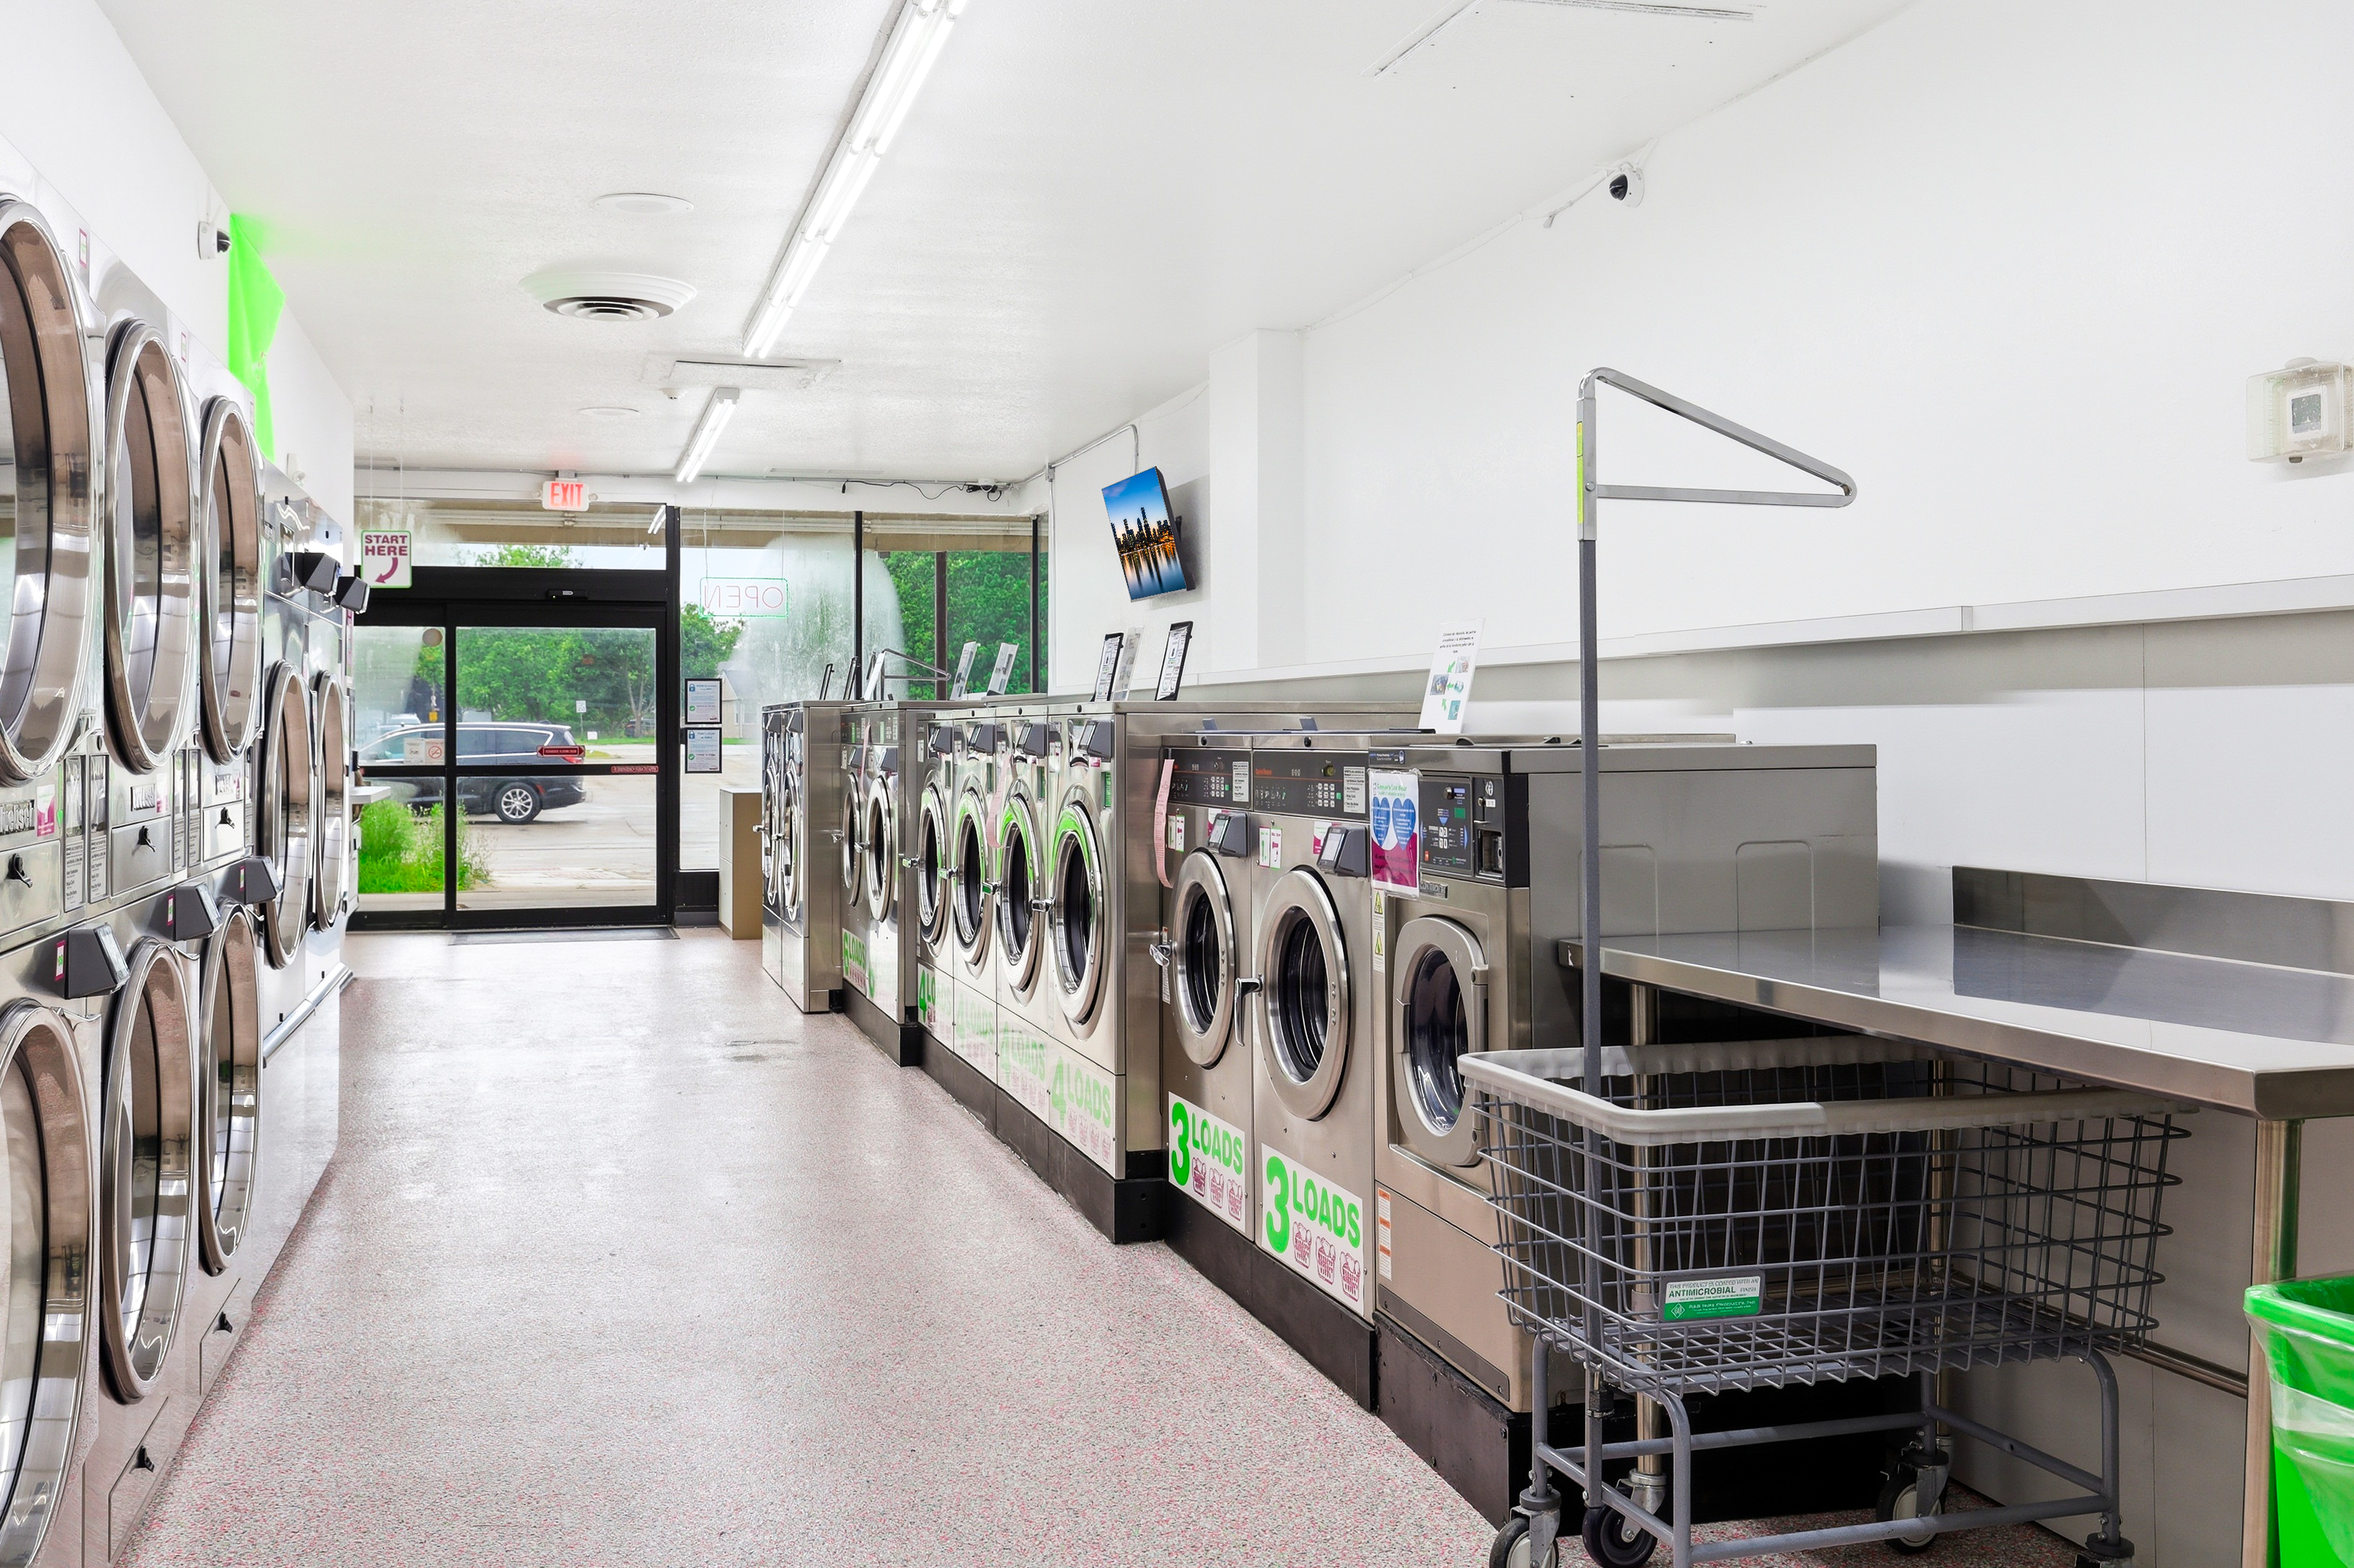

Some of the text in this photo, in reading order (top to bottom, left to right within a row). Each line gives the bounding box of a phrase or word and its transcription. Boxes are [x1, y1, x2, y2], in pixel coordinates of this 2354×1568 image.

[551, 483, 583, 507] EXIT
[365, 535, 408, 544] START
[365, 546, 408, 556] HERE
[919, 969, 927, 1023] 4
[1000, 1021, 1045, 1085] 4 LOADS
[1051, 1056, 1111, 1128] 4 LOADS
[1171, 1102, 1243, 1186] 3 LOADS
[1266, 1156, 1290, 1253] 3
[1292, 1170, 1360, 1248] LOADS
[1669, 1286, 1736, 1298] ANTIMICROBIAL
